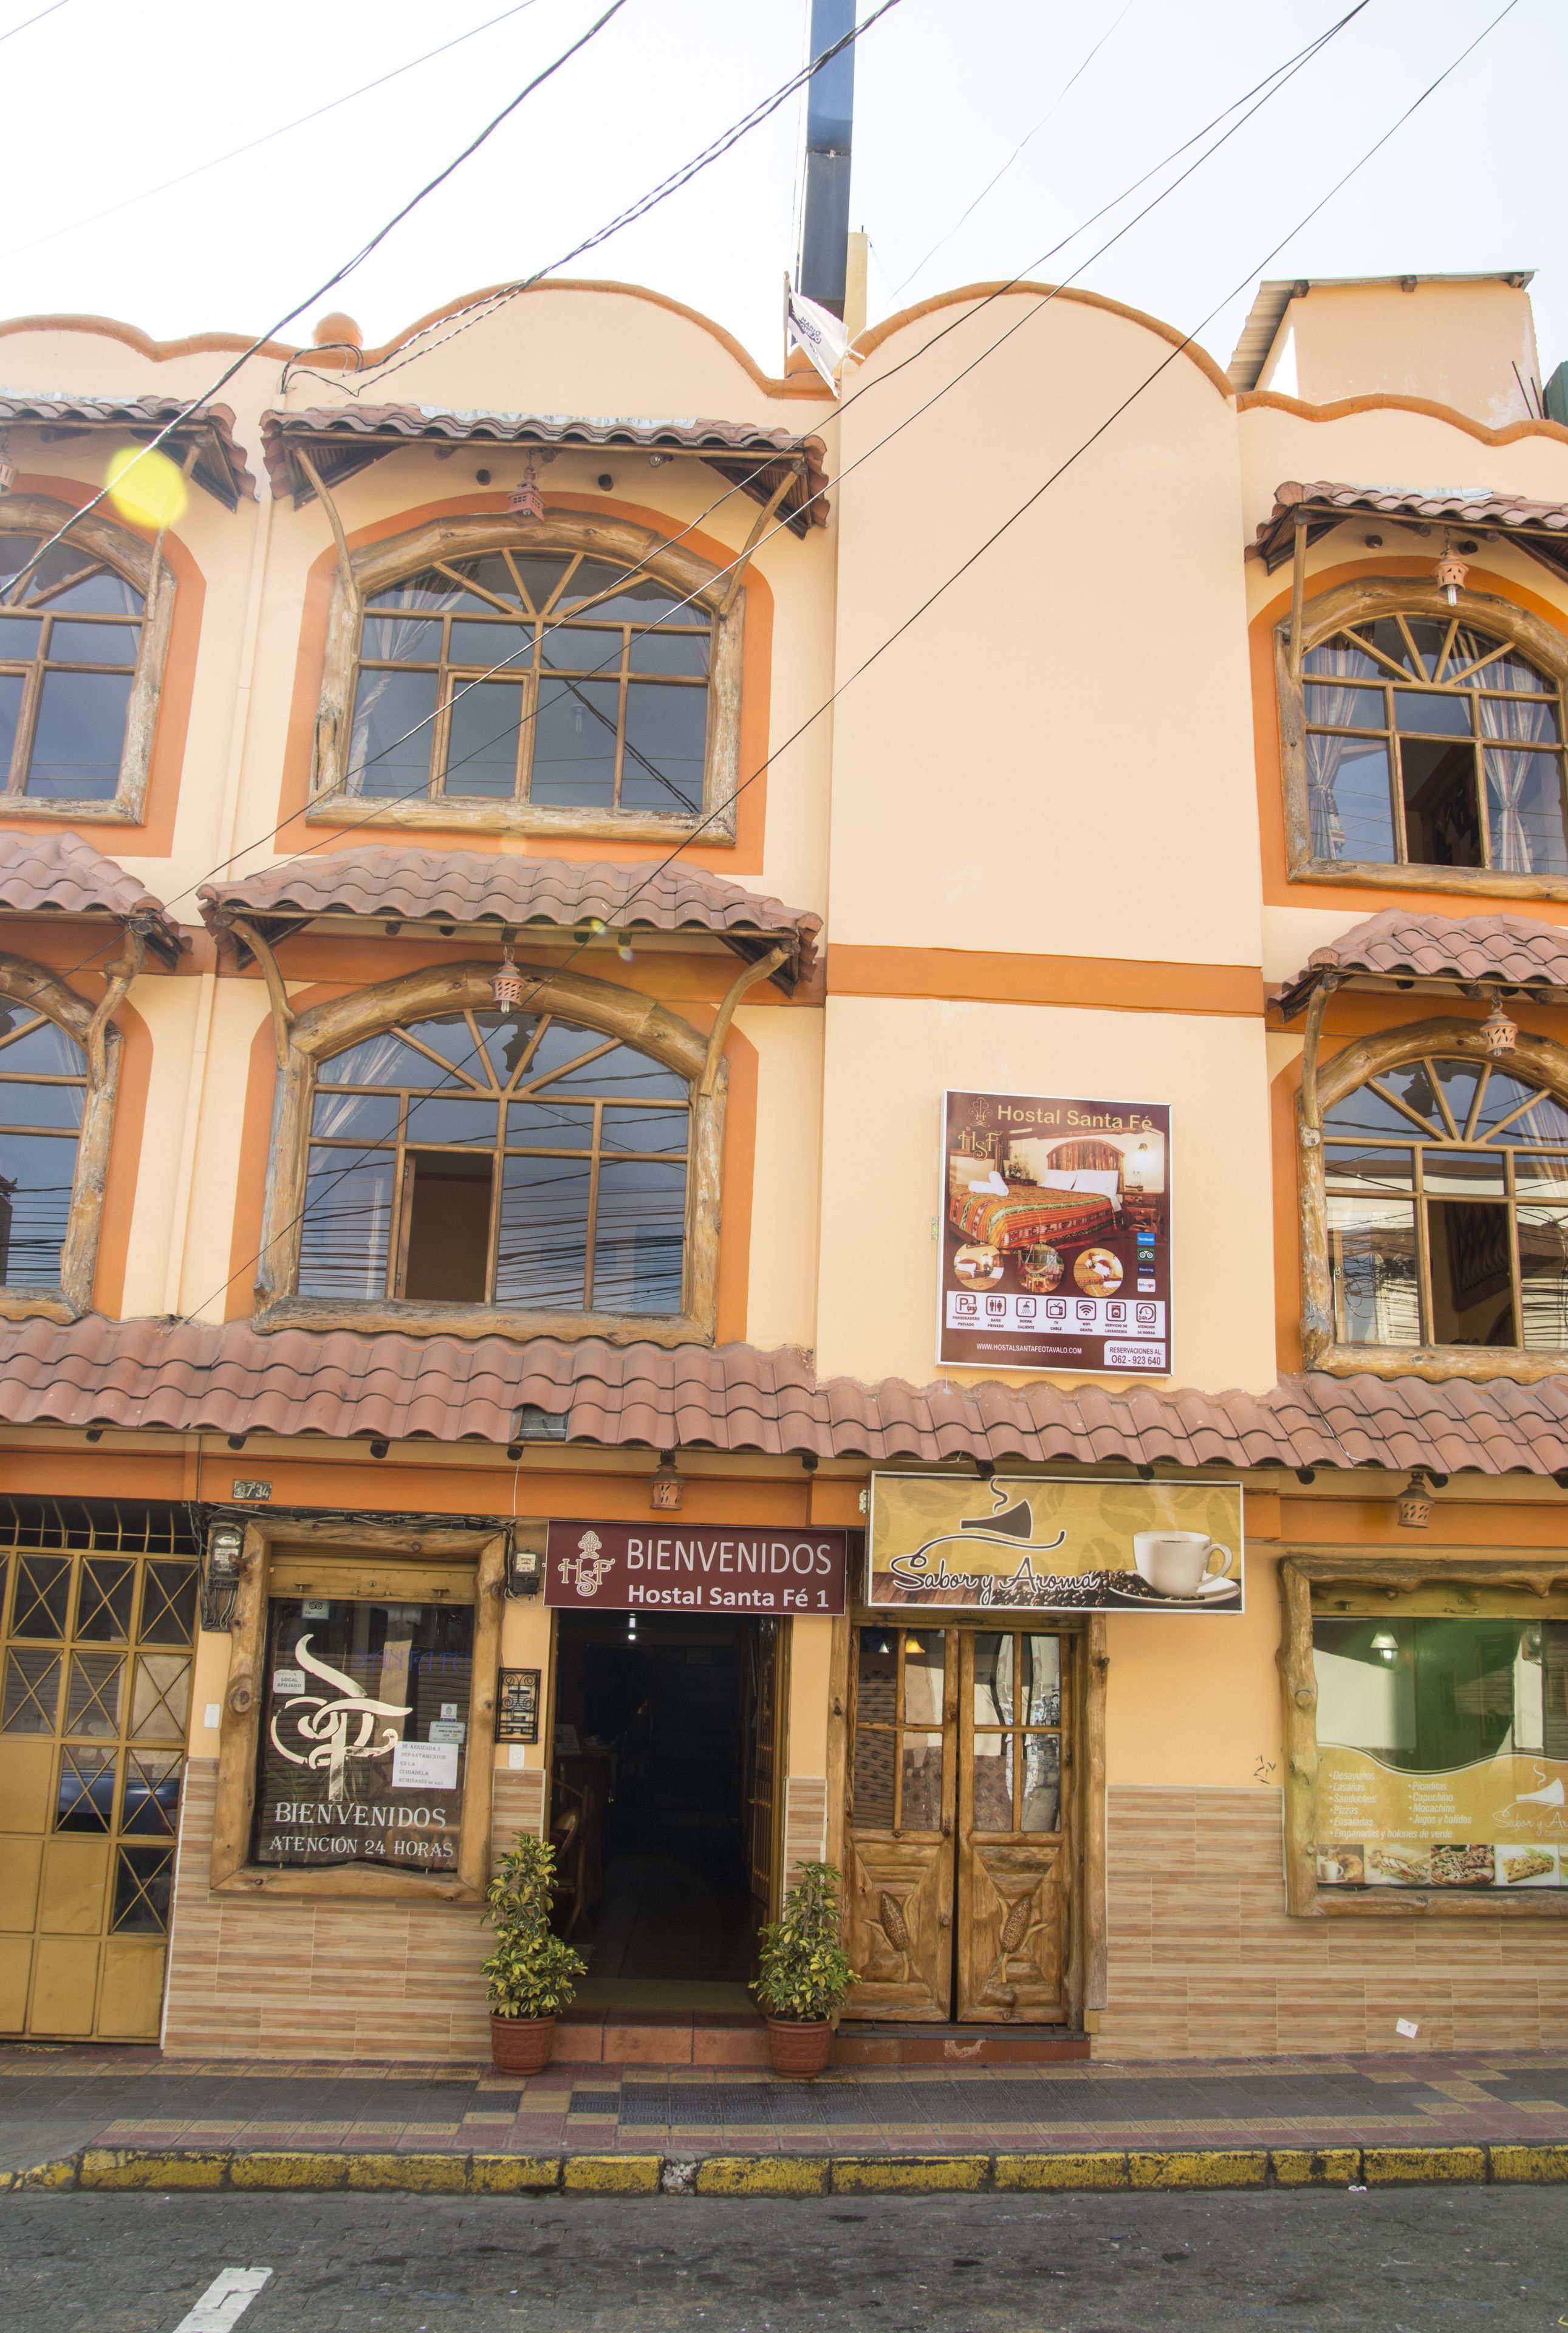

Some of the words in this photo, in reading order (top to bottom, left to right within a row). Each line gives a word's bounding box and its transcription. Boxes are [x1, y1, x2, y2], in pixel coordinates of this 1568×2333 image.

[798, 320, 822, 344] ONEJO
[801, 317, 821, 336] MARIO
[998, 1105, 1060, 1125] Hostal
[1066, 1110, 1123, 1129] Santa
[1129, 1114, 1152, 1131] Fé
[976, 1343, 1082, 1354] WWW.HOSTALSANTAFEOTAVALO.COM
[1132, 1356, 1146, 1365] 923
[1148, 1356, 1161, 1365] 640
[627, 1538, 831, 1575] BIENVENIDOS
[890, 1554, 977, 1591] Sabor
[980, 1574, 995, 1606] y
[999, 1556, 1100, 1594] Aroma
[628, 1584, 702, 1606] Hostal
[710, 1587, 775, 1607] Santa
[783, 1588, 809, 1607] Fé
[817, 1590, 829, 1608] 1
[1333, 1771, 1375, 1780] Desayunos
[1333, 1783, 1364, 1791] Lasañas
[1412, 1781, 1447, 1790] Picaditas
[1334, 1794, 1376, 1803] Sanduches
[1412, 1792, 1453, 1803] Capuchino
[1333, 1805, 1358, 1814] Pizzas
[1413, 1803, 1455, 1813] Mocachino
[274, 1802, 446, 1828] BIENVENIDOS
[1412, 1814, 1436, 1825] Jugos
[1444, 1815, 1472, 1823] batidos
[1493, 1811, 1533, 1828] Sabor
[1334, 1817, 1373, 1826] Ensaladas
[1334, 1829, 1379, 1839] Empanadas
[1388, 1829, 1417, 1838] bolones
[269, 1835, 358, 1853] ATENCIÓN
[365, 1840, 385, 1854] 24
[394, 1840, 453, 1858] HORAS
